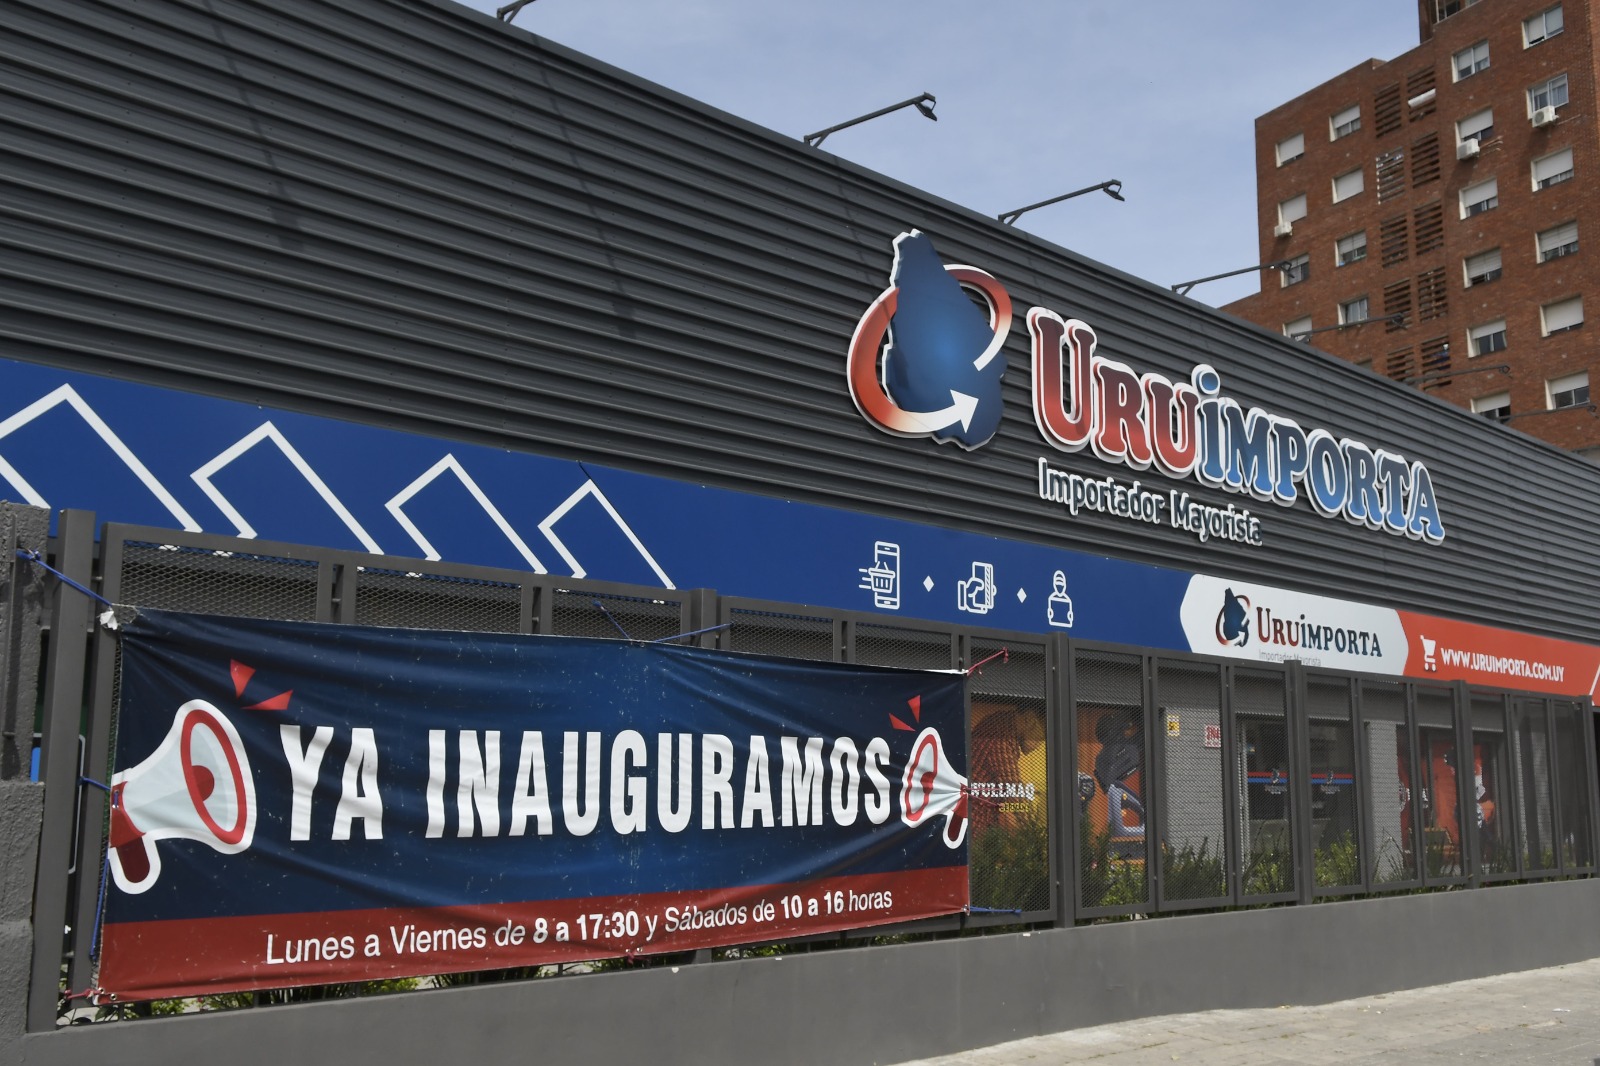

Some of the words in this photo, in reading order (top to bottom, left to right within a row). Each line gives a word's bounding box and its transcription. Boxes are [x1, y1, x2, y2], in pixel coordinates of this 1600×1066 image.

[1038, 457, 1165, 516] Importador
[1170, 489, 1263, 546] Mayorista
[1440, 647, 1565, 683] WWW.URUIMPORTA.COM.UY
[279, 723, 385, 841] YA
[425, 728, 892, 839] INAUGURAMOS
[266, 933, 355, 965] Lunes
[363, 933, 381, 957] a
[389, 924, 487, 955] Viernes
[494, 919, 526, 946] de
[532, 917, 549, 944] 8
[555, 920, 570, 942] a
[576, 910, 639, 941] 17:30
[645, 914, 658, 941] y
[664, 903, 748, 933] Sábados
[752, 899, 776, 923] de
[780, 894, 803, 919] 10
[807, 898, 819, 918] a
[823, 890, 844, 914] 16
[848, 889, 893, 912] horas
